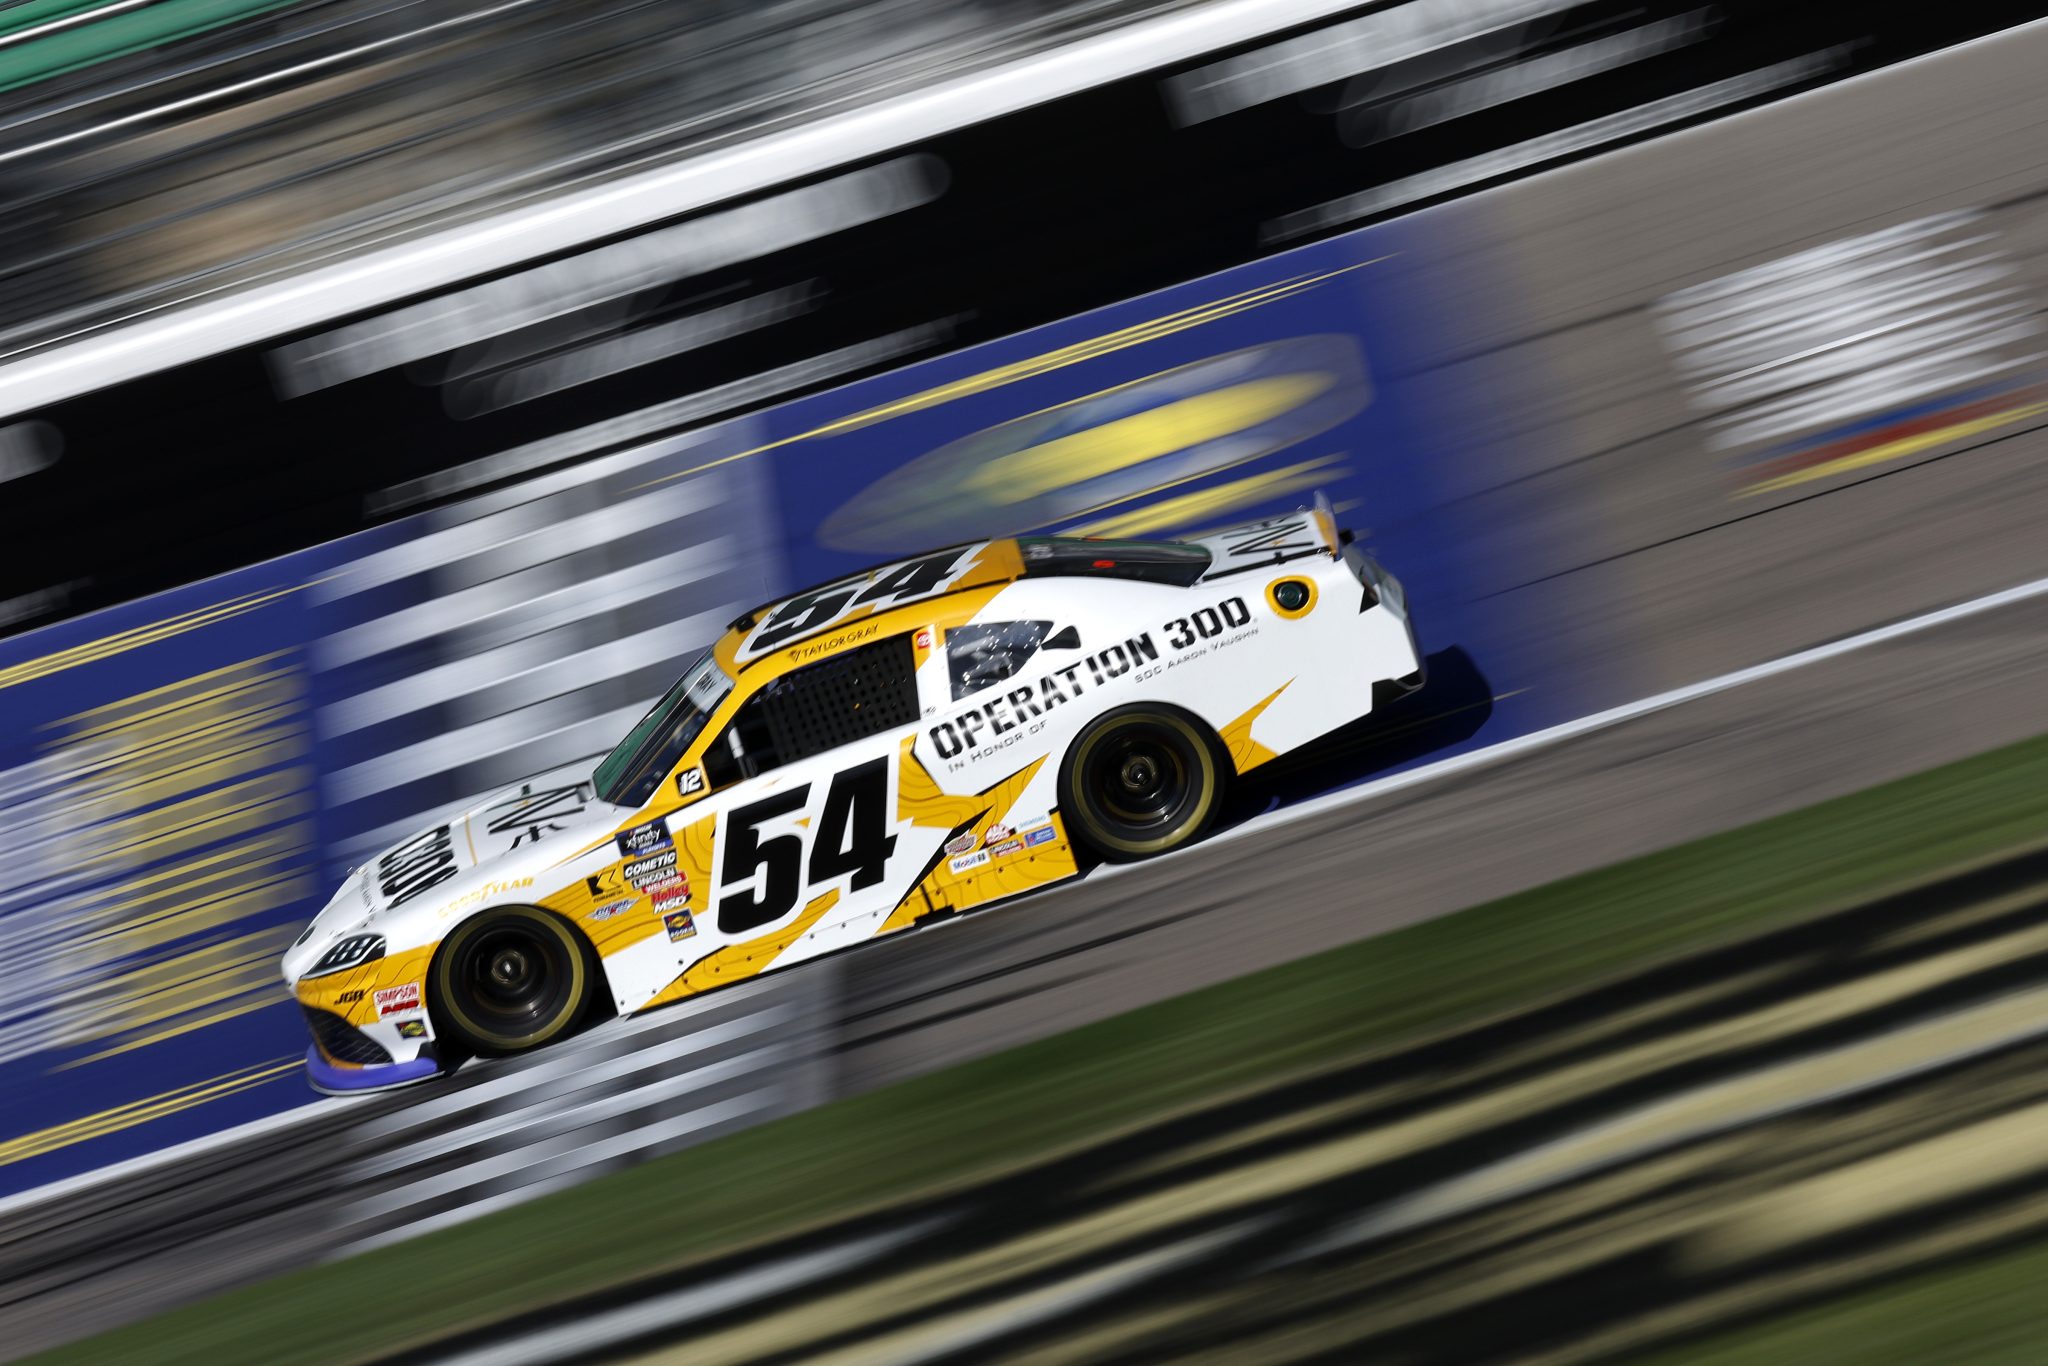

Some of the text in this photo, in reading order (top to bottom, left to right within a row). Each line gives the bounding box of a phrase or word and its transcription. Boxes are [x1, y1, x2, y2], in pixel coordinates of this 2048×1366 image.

[801, 622, 879, 658] TAYLOR GRAY
[928, 596, 1252, 760] OPERATION 300
[970, 730, 1024, 762] HONOR
[679, 768, 702, 795] 12
[717, 754, 899, 934] 54
[624, 851, 676, 879] COMETIC
[633, 867, 676, 889] LINCOLN
[654, 896, 688, 915] MSD
[375, 983, 417, 1006] SIMPSON
